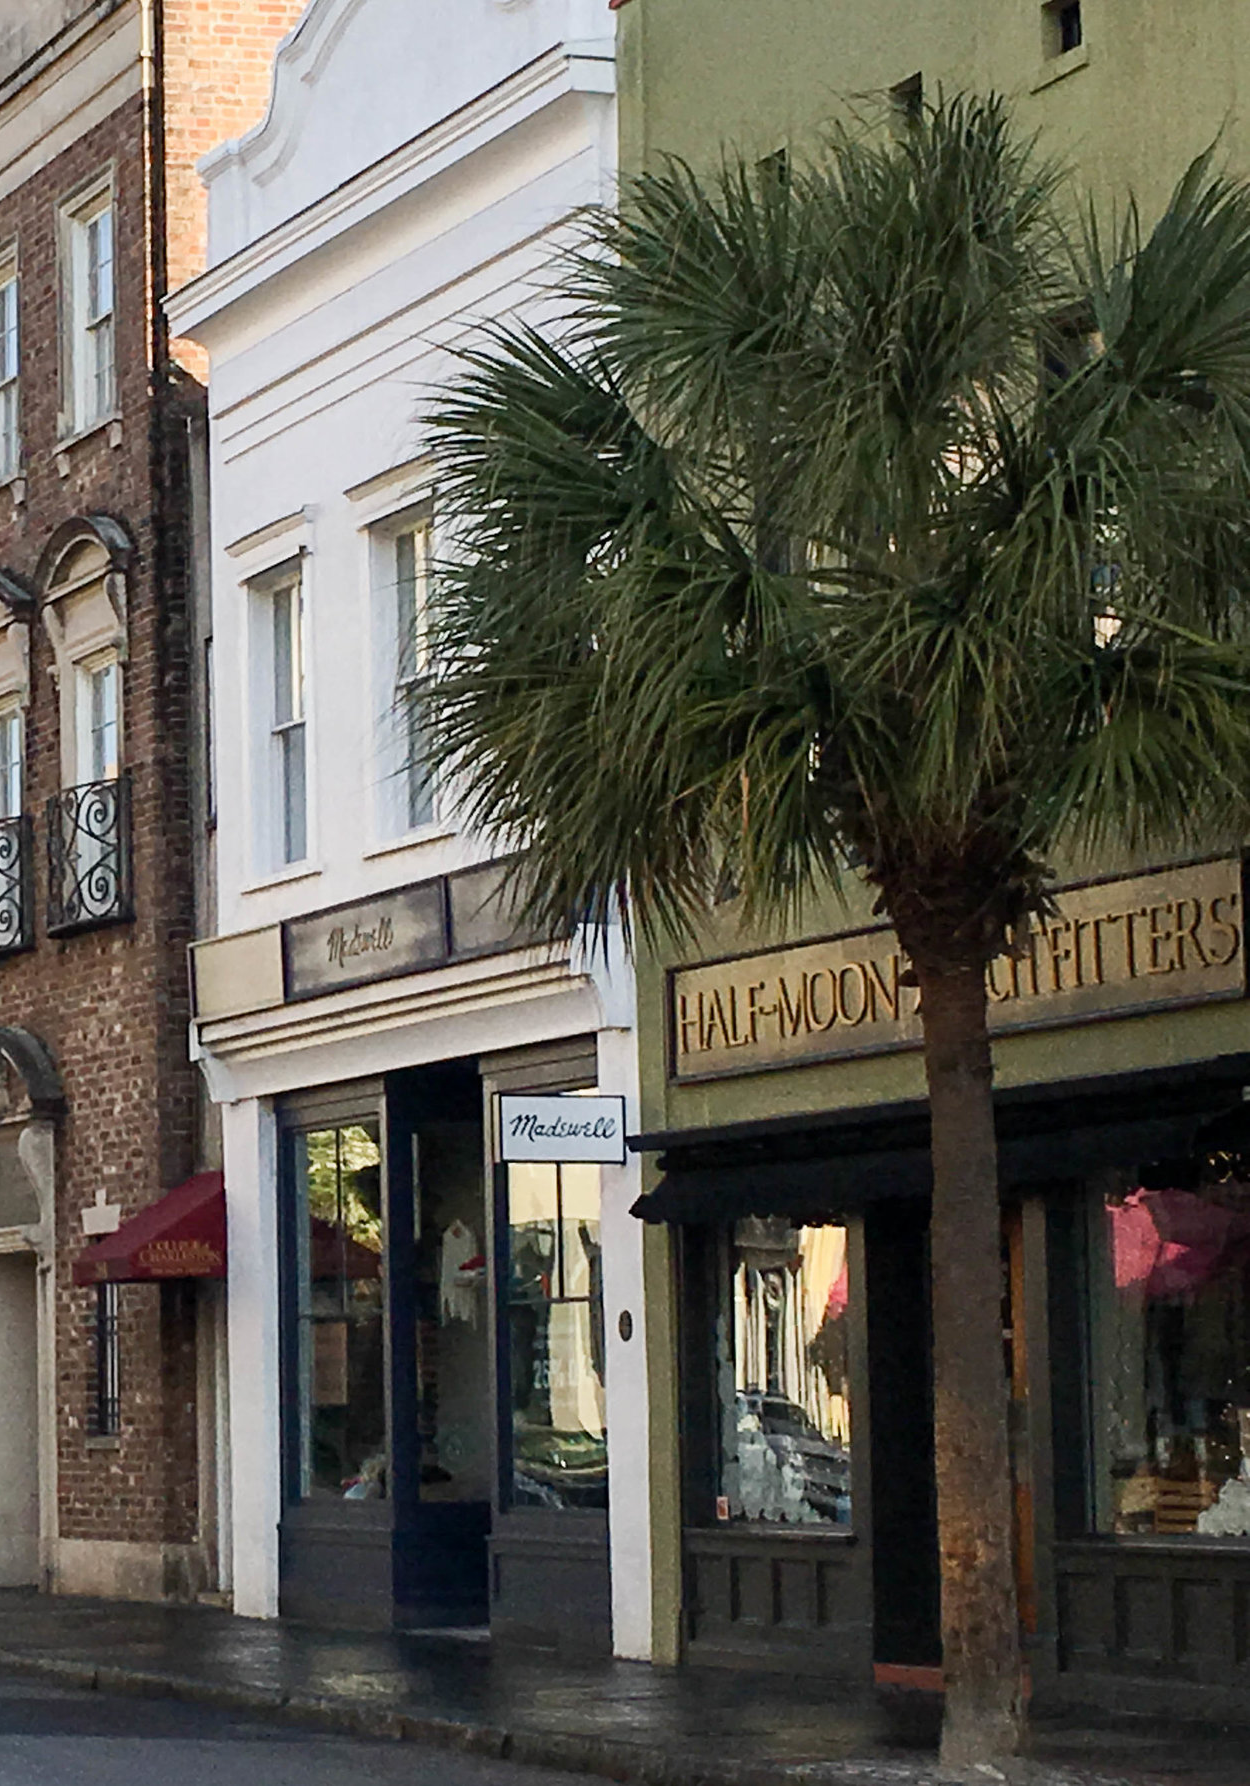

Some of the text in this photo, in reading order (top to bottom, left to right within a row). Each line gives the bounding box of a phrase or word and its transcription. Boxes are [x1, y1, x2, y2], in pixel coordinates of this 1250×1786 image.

[327, 917, 393, 968] Madewell
[680, 893, 1240, 1054] HALF-MOON UTFITTERS
[510, 1114, 616, 1142] Madewell
